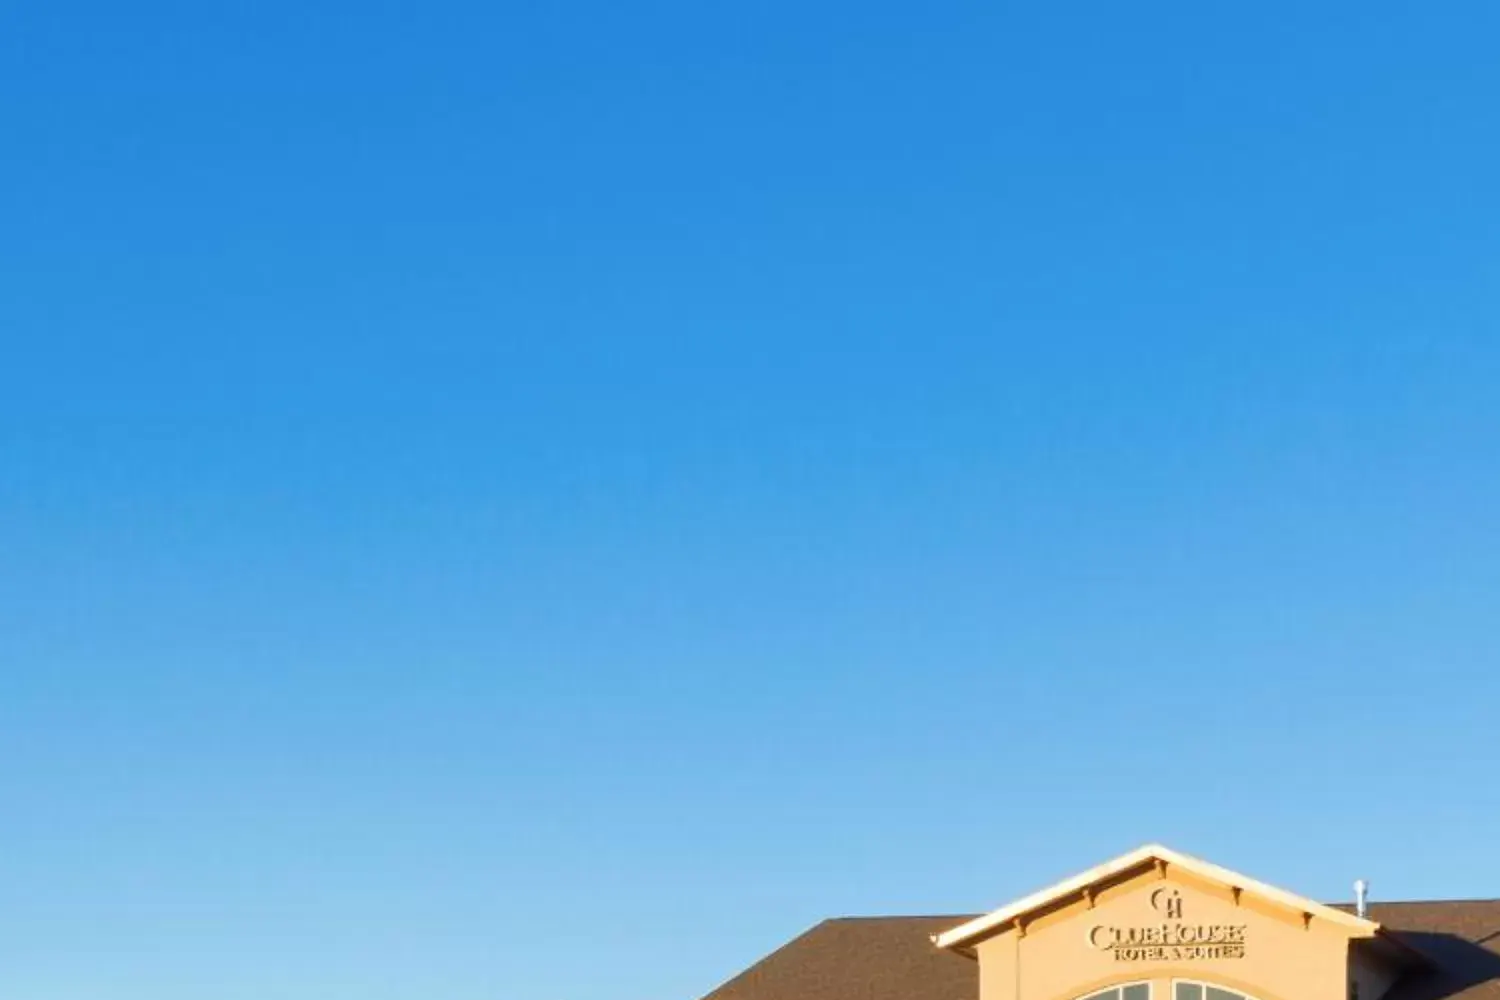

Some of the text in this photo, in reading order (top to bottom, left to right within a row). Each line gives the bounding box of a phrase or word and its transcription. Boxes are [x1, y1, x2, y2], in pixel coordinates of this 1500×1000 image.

[1089, 923, 1246, 950] CLUBHOUSE
[1114, 947, 1168, 961] HOTEL
[1185, 946, 1245, 960] SUITES
